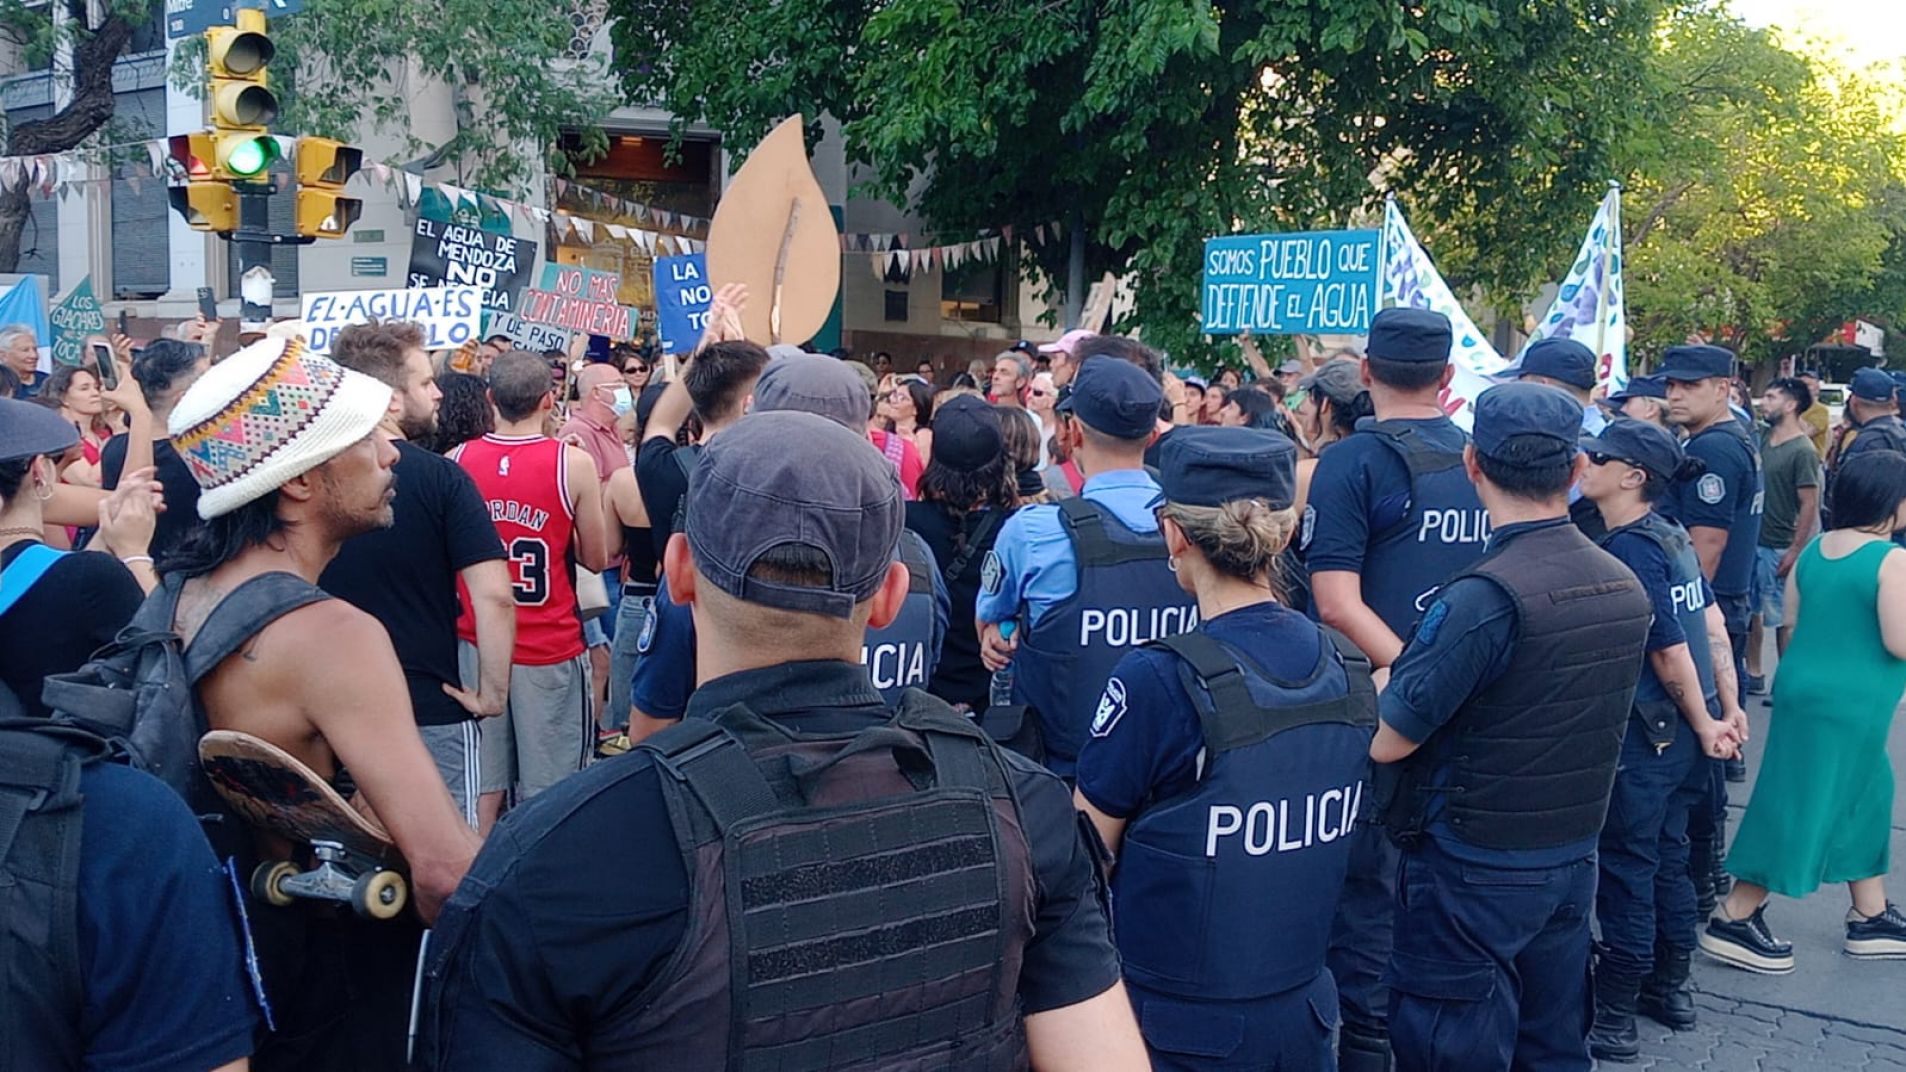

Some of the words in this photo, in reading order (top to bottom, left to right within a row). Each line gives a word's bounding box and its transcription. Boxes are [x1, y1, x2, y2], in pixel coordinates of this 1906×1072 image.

[416, 218, 436, 238] EL
[442, 225, 484, 249] AGUA
[495, 236, 517, 256] DE
[437, 240, 517, 275] MENDOZA
[672, 262, 700, 281] LA
[1208, 249, 1256, 276] SOMOS
[1259, 239, 1332, 280] PUEBLO
[1338, 242, 1371, 272] QUE
[446, 261, 497, 289] NO
[556, 270, 583, 294] NO
[72, 295, 93, 310] LOS
[680, 285, 712, 306] NO
[1206, 284, 1286, 330] DEFIENDE
[1286, 294, 1305, 318] EL
[1307, 283, 1370, 330] AGUA
[494, 313, 504, 328] Y
[506, 318, 526, 337] DE
[529, 326, 565, 351] PASO
